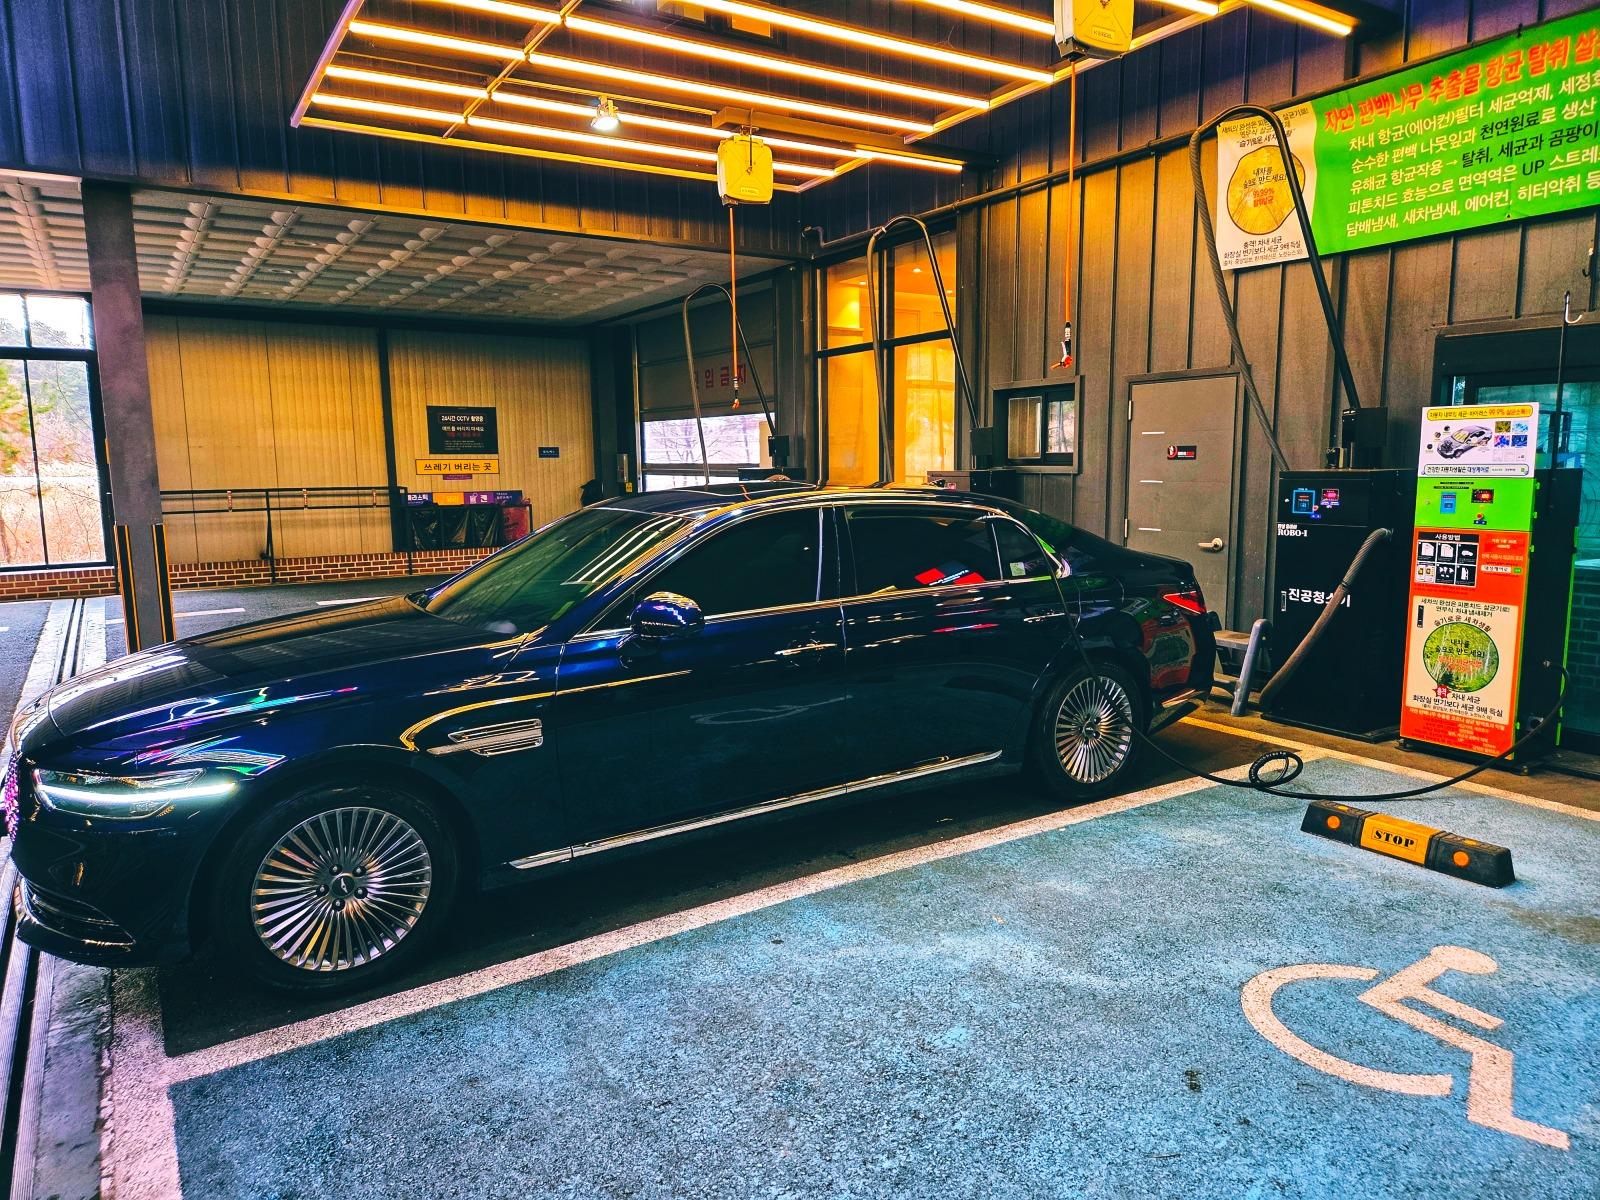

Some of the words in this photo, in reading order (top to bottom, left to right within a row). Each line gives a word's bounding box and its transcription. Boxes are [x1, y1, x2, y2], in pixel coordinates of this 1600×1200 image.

[1324, 103, 1355, 134] 자연
[1358, 83, 1425, 126] 편백나무
[1428, 63, 1482, 105] 추출물
[1486, 50, 1524, 88] 항균
[1528, 36, 1571, 77] 탈취
[1575, 28, 1600, 64] 살
[1349, 132, 1375, 151] 차내
[1378, 101, 1484, 145] 항균(에어컨)필터
[1488, 83, 1553, 113] 세균억제,
[1352, 150, 1389, 174] 순수한
[1391, 143, 1418, 163] 편백
[1420, 127, 1477, 154] 나뭇잎과
[1480, 107, 1557, 140] 천연원료로
[1562, 96, 1597, 120] 생산
[1348, 192, 1398, 215] 피톤치드
[1401, 179, 1454, 204] 효능으로
[1459, 164, 1518, 191] 면역역은
[1522, 160, 1545, 176] UP
[1548, 145, 1600, 171] 스트레
[1350, 173, 1387, 195] 유해균
[1391, 159, 1444, 185] 항균작용
[1462, 146, 1493, 168] 탈취,
[1498, 134, 1544, 158] 세균과
[1548, 120, 1599, 148] 곰팡이
[1346, 213, 1399, 237] 담배냄새,
[1403, 200, 1460, 225] 새차냄새,
[1465, 189, 1513, 212] 에어컨,
[1518, 174, 1581, 201] 히터악취
[424, 463, 451, 471] 쓰레기
[454, 463, 481, 471] 버리는
[483, 463, 492, 471] 곳
[1413, 694, 1432, 705] 화장실
[1433, 698, 1460, 709] 변기보다
[1460, 703, 1475, 712] 세균
[1451, 693, 1466, 702] 차내
[1466, 696, 1481, 705] 세균
[1373, 830, 1415, 848] STOP
